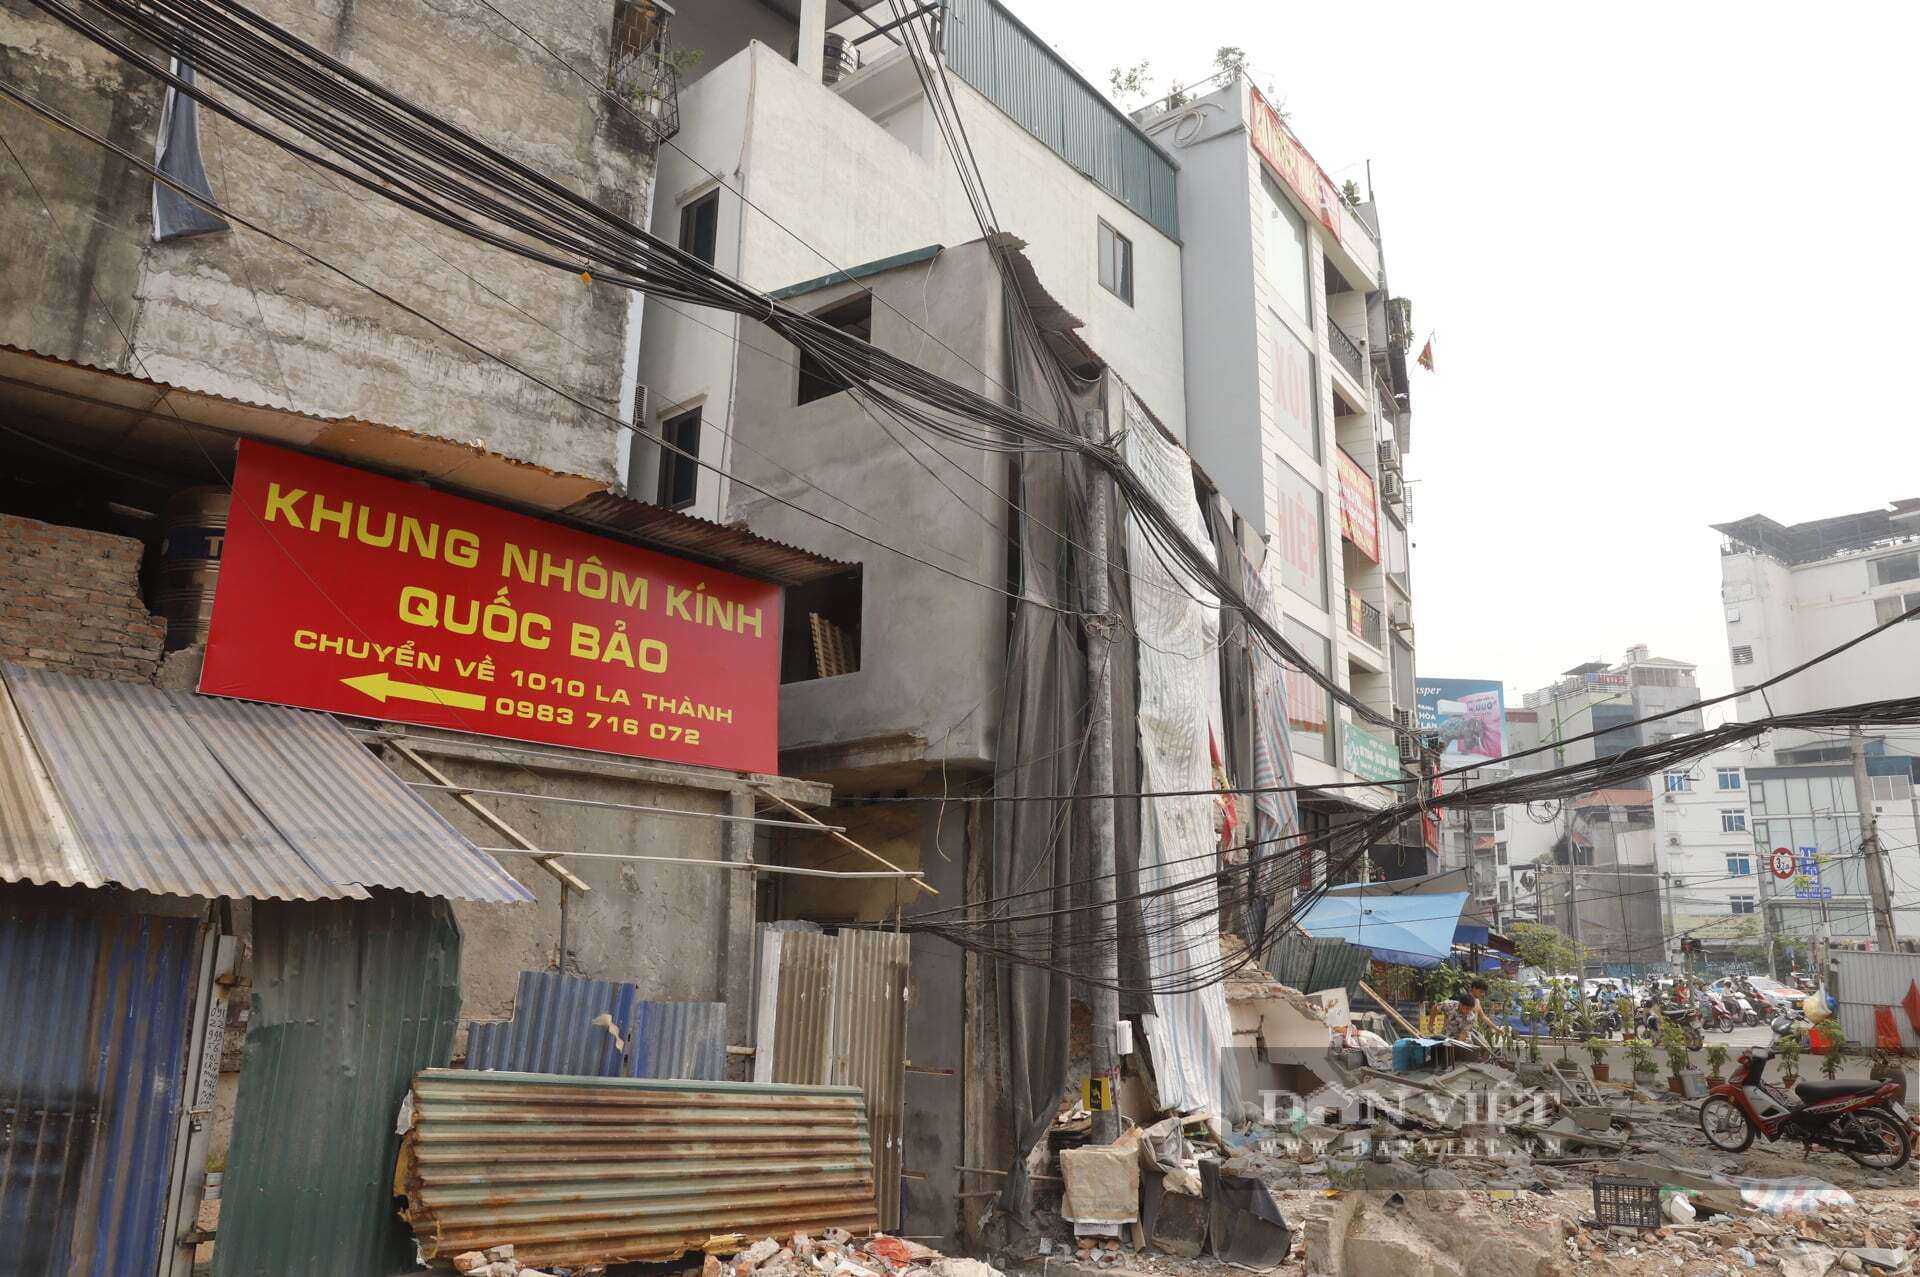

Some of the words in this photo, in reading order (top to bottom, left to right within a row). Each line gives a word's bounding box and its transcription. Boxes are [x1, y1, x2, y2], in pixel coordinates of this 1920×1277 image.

[263, 482, 480, 569] KHUNG
[502, 543, 649, 610] NHÔM
[666, 582, 764, 639] KÍNH
[398, 586, 551, 650] QUỐC
[569, 621, 669, 674] BẢO
[293, 629, 442, 672] CHUYỂN
[454, 655, 496, 682] VỀ
[511, 670, 585, 699] 1010
[595, 685, 632, 707] LA
[642, 691, 734, 724] THÀNH
[495, 697, 574, 726] 0983
[585, 713, 639, 738] 716
[649, 722, 702, 745] 072
